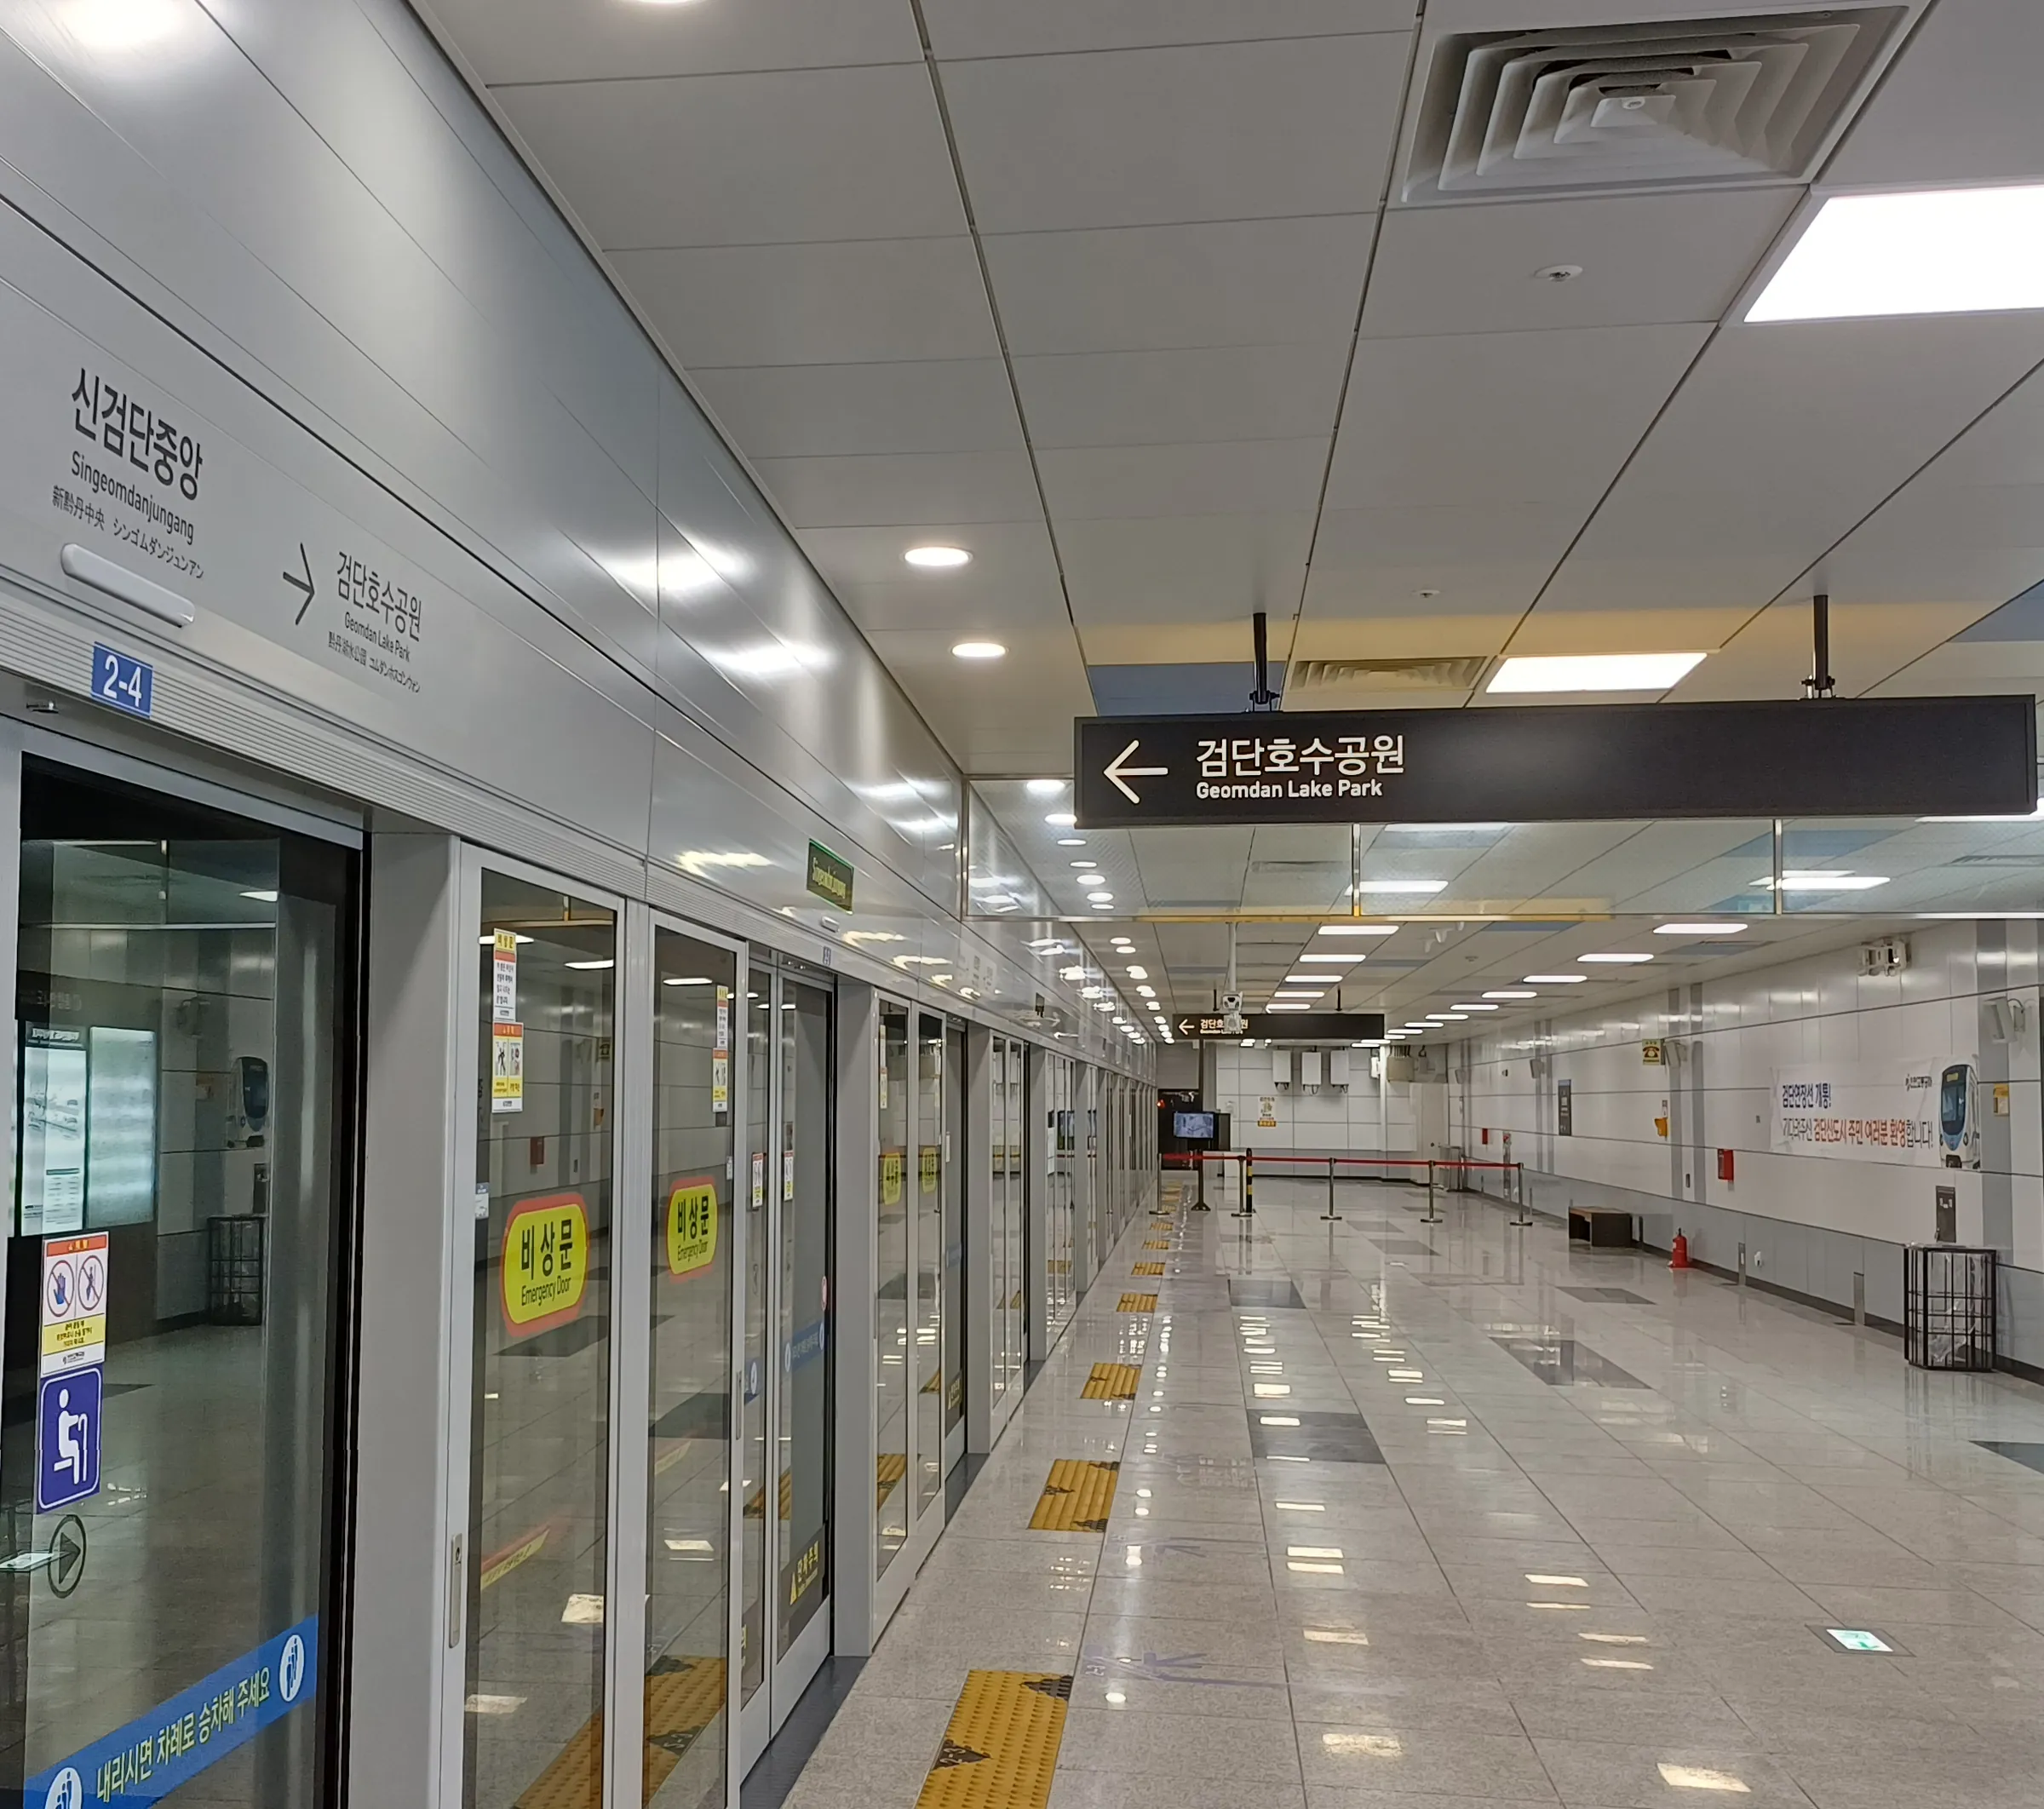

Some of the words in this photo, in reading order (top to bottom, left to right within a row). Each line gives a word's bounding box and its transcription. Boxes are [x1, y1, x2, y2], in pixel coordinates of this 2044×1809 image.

[72, 368, 203, 501] 신검단중앙
[72, 451, 194, 545] Singeomdanjungang
[337, 551, 422, 642] 검단호수공원
[344, 611, 377, 645] Geomdan
[378, 629, 393, 653] Lake
[394, 640, 411, 663] Park
[103, 655, 142, 708] 2-4
[1196, 734, 1405, 778] 검단호수공원
[1196, 781, 1283, 799] Geomdan
[1288, 779, 1333, 798] Lake
[1338, 778, 1382, 797] Park
[1200, 1019, 1249, 1030] 검단호원
[1783, 1083, 1813, 1108] 검단연장선
[1816, 1082, 1831, 1109] 개통!
[1814, 1118, 1846, 1145] 검단신도시
[1848, 1120, 1863, 1145] 주민
[1864, 1120, 1888, 1146] 여러분
[1890, 1118, 1933, 1148] 환영합니다!
[678, 1196, 709, 1241] 비상문
[521, 1219, 572, 1280] 비상문
[677, 1242, 698, 1262] Emergency
[699, 1239, 708, 1256] Door
[521, 1279, 555, 1306] Emergency
[557, 1276, 571, 1295] Door
[95, 1735, 154, 1804] 내리시면
[157, 1712, 196, 1766] 차례로
[198, 1686, 235, 1744] 승차해
[237, 1667, 270, 1718] 주세요
